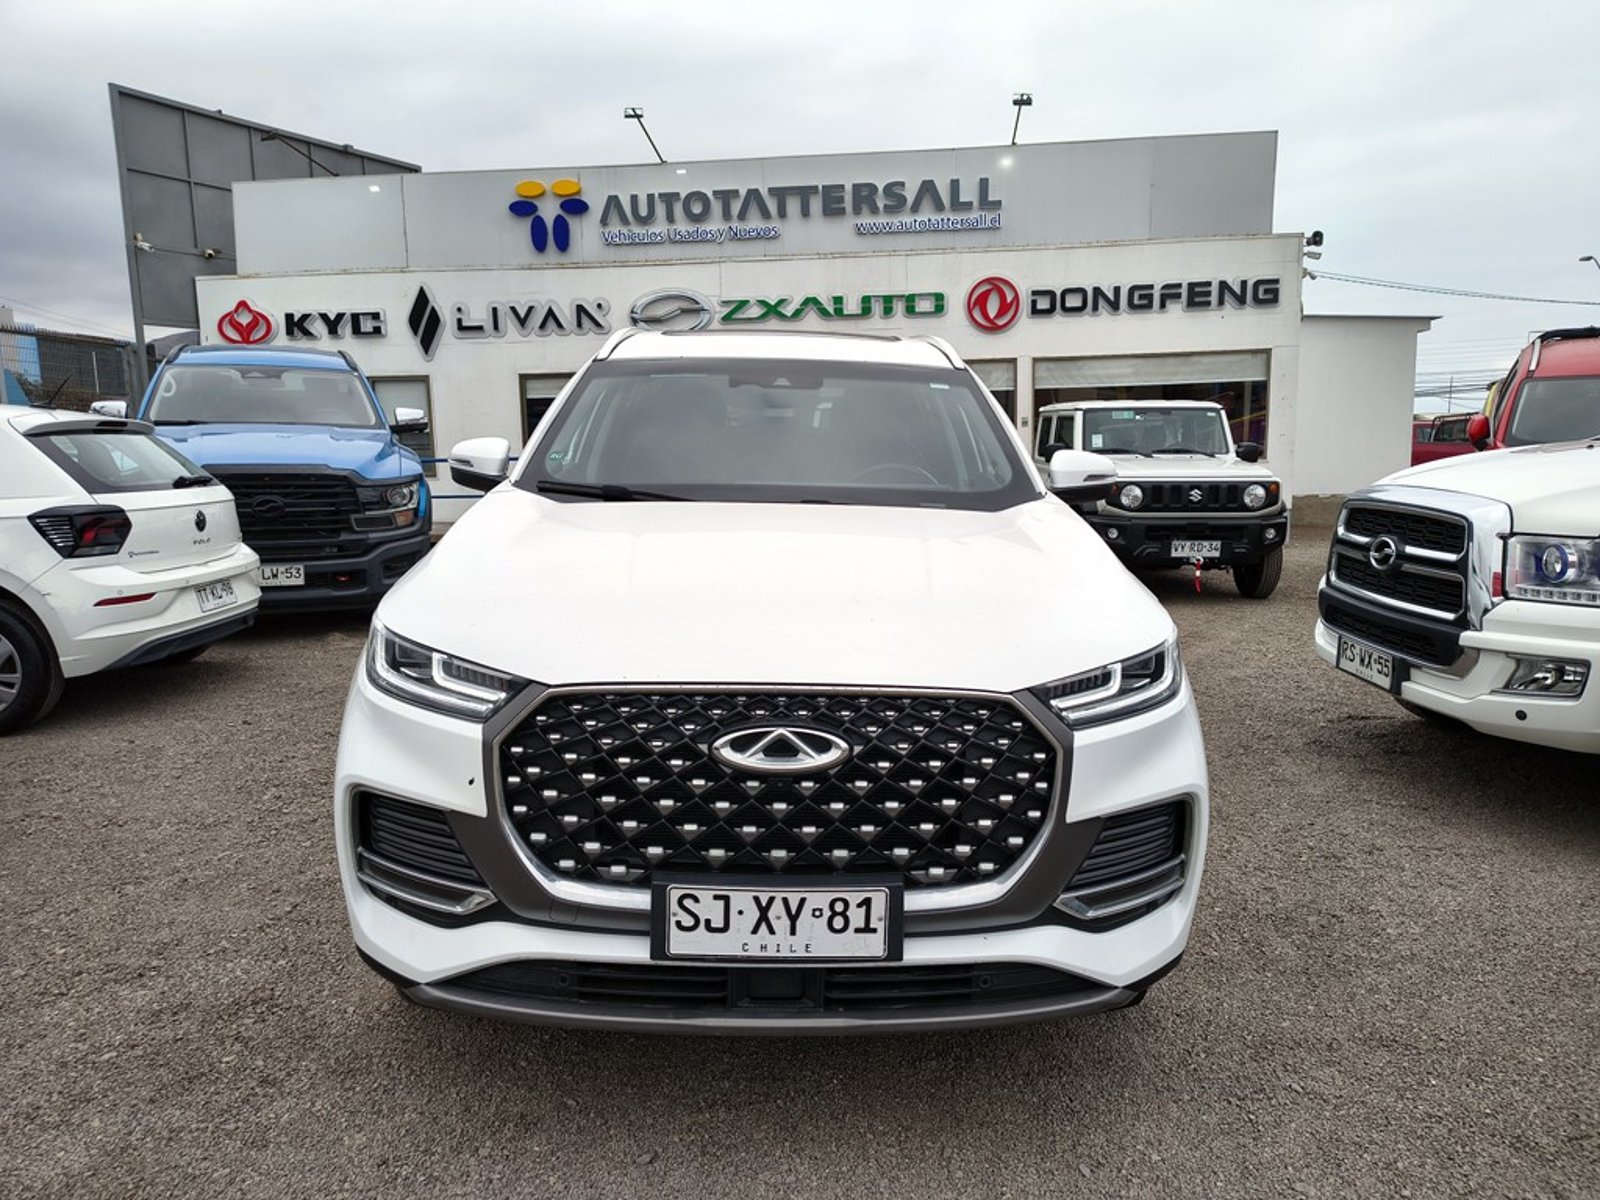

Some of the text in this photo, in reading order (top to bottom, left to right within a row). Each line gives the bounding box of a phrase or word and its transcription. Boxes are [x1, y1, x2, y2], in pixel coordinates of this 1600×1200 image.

[600, 177, 1002, 226] AUTOTATTERSALL
[667, 225, 715, 243] Usados
[716, 226, 725, 243] y
[728, 224, 779, 241] Nuevos
[855, 213, 1001, 233] www.autotattersall.cl
[720, 292, 945, 321] ZXAUTO
[1030, 278, 1280, 315] DONGFENG
[284, 312, 382, 336] KYC
[456, 302, 604, 332] LIVAN
[741, 943, 812, 953] CHILE
